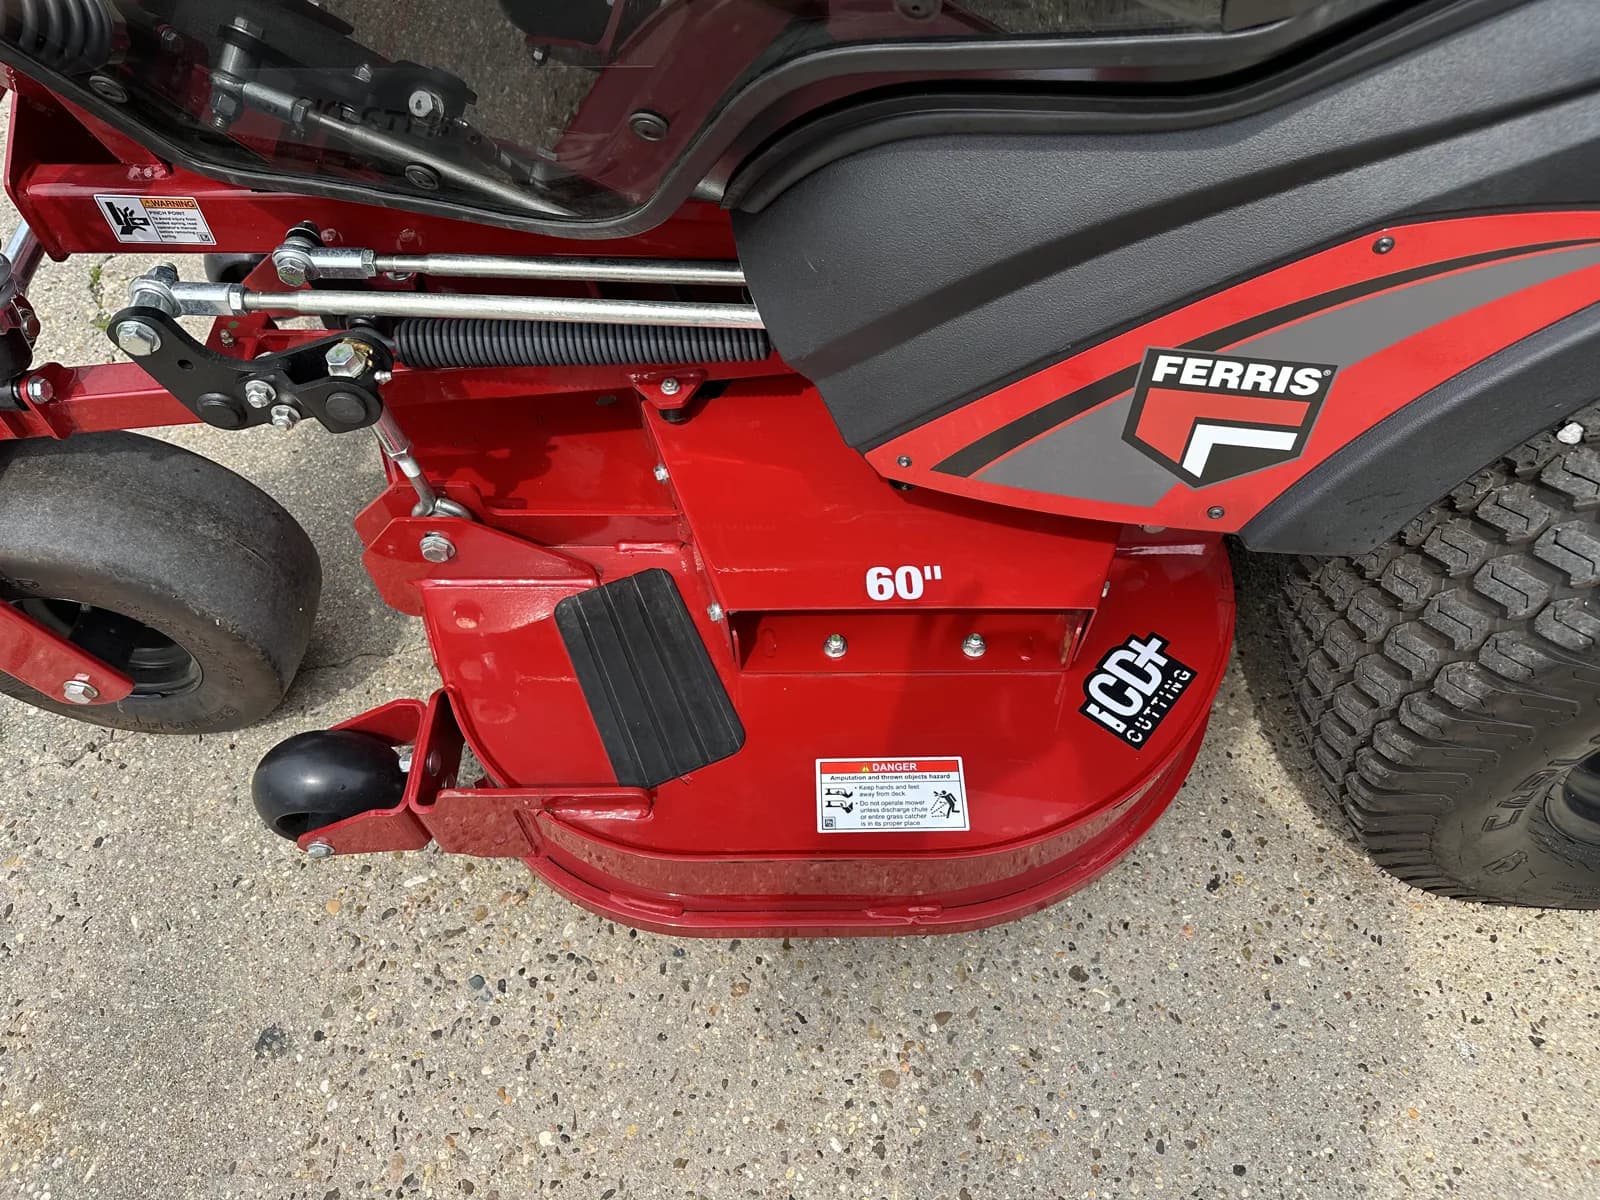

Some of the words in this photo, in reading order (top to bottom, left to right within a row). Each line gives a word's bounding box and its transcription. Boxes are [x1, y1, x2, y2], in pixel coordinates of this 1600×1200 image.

[866, 565, 942, 601] 60"
[1126, 669, 1191, 742] CUTTING
[872, 762, 918, 772] DANGER
